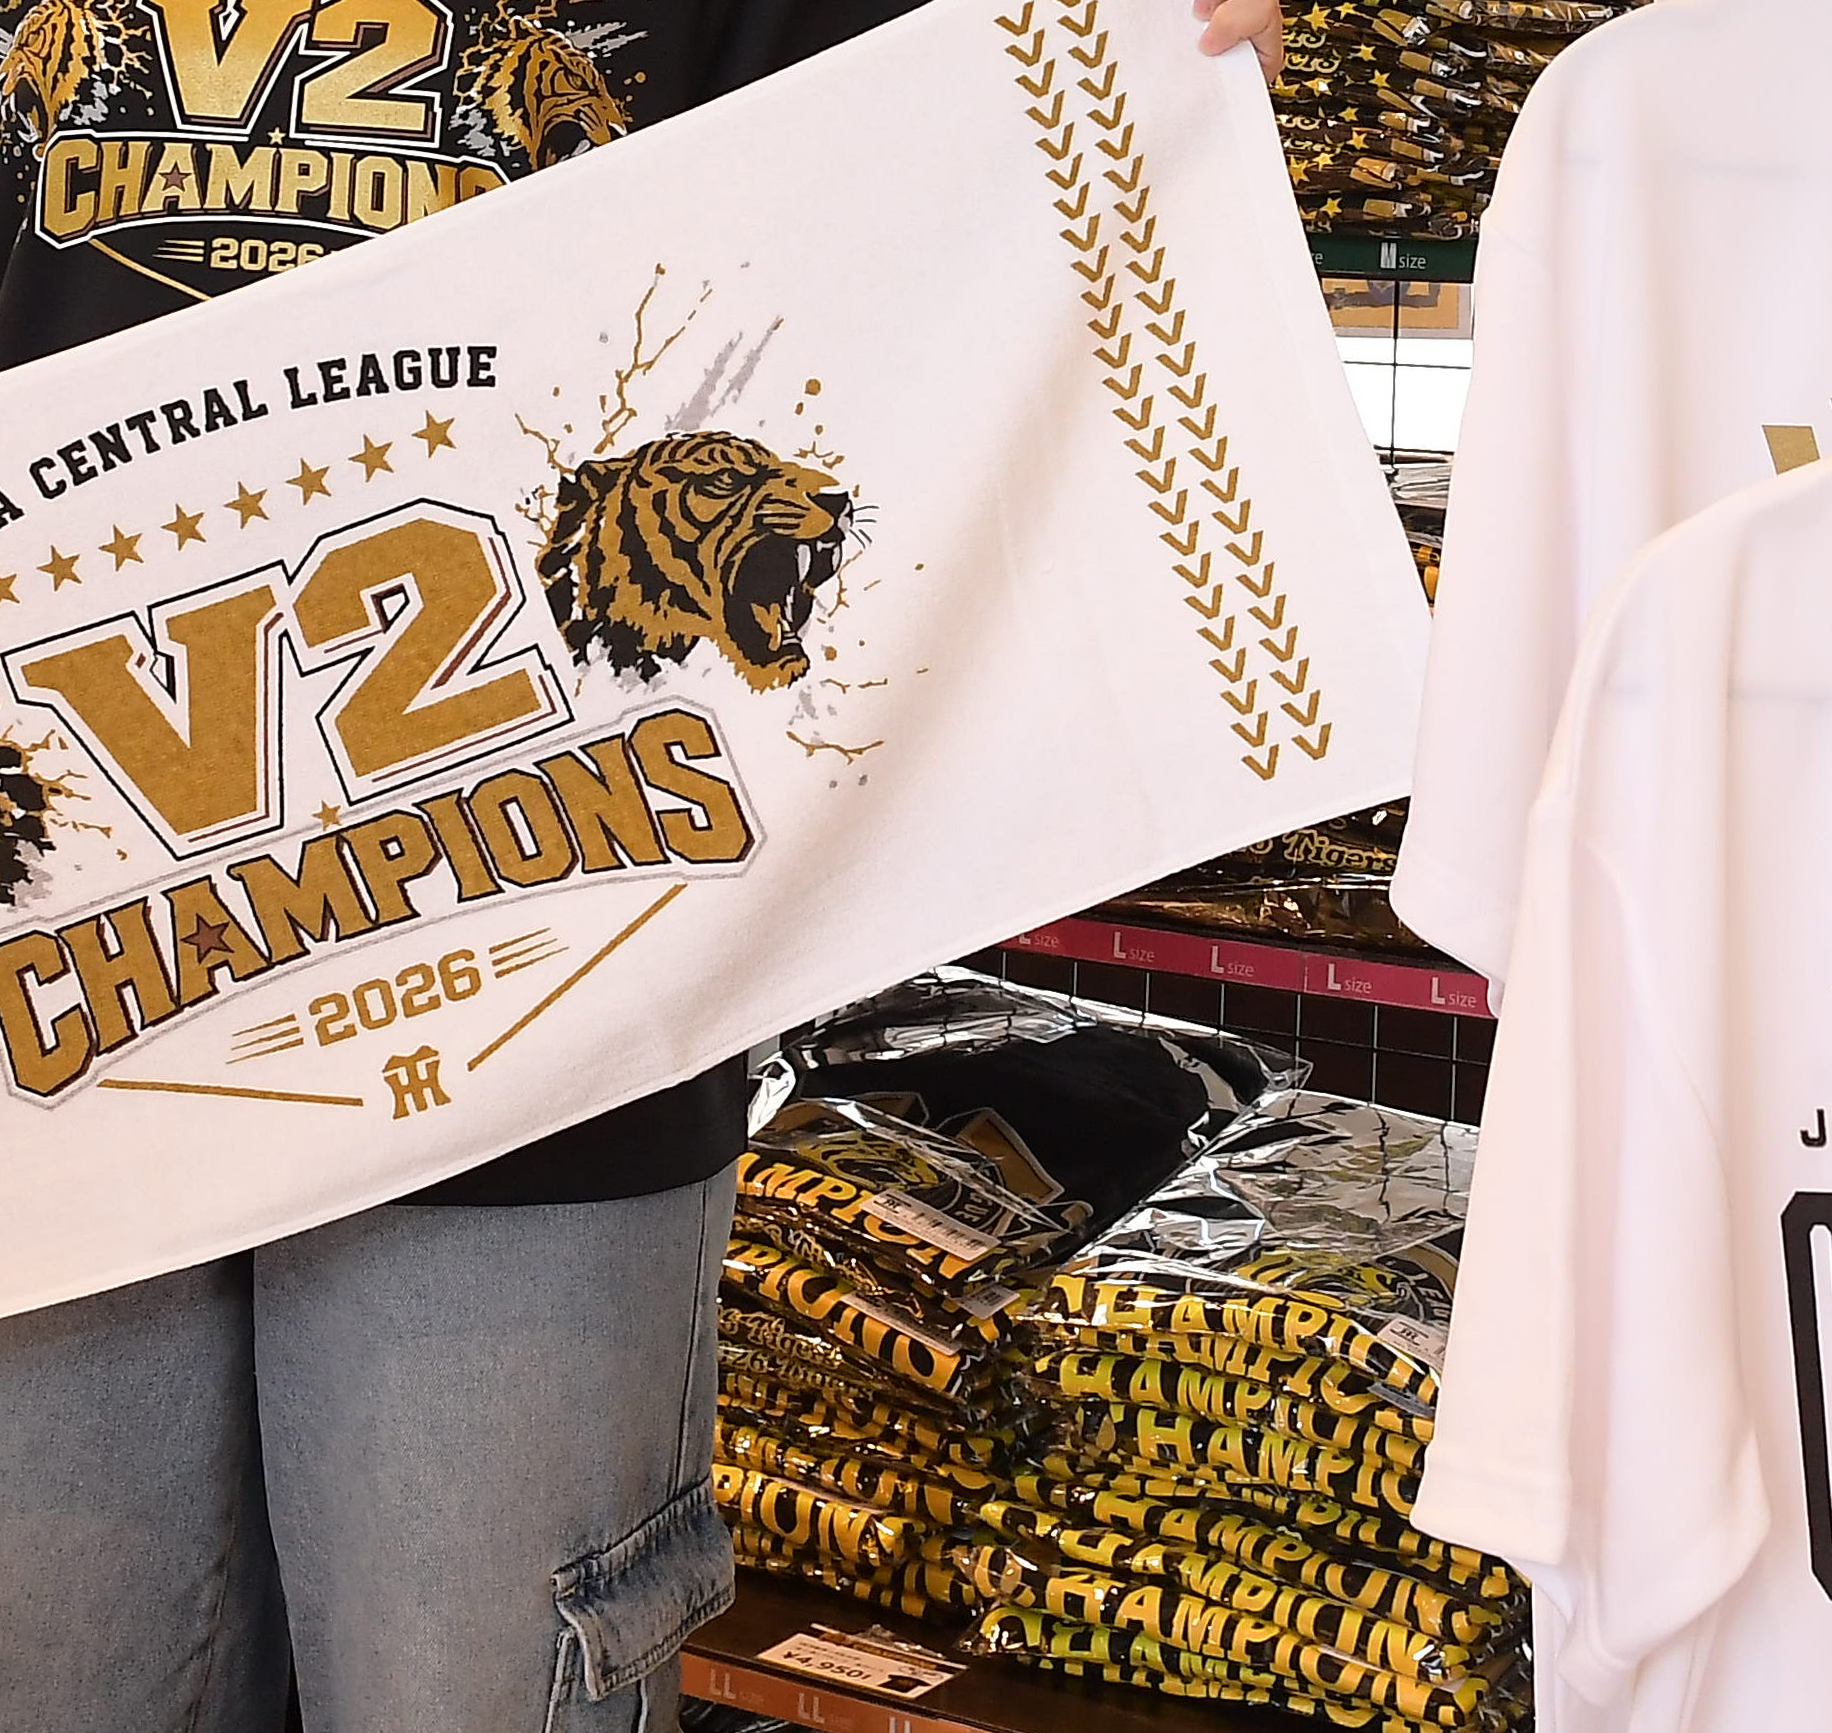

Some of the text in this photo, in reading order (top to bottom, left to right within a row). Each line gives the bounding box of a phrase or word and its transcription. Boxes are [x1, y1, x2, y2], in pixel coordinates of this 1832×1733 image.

[1399, 251, 1426, 269] size
[27, 380, 269, 503] CENTRAL
[285, 345, 499, 411] LEAGUE
[7, 503, 571, 858] V2
[308, 953, 484, 1044] 2026
[1113, 931, 1126, 959] L
[1129, 947, 1155, 963] size
[1211, 945, 1224, 974] L
[1227, 961, 1254, 978] size
[1328, 962, 1341, 990] L
[1344, 977, 1372, 994] size
[1431, 977, 1445, 1005] L
[1448, 992, 1477, 1009] size
[709, 1668, 826, 1724] LL LL
